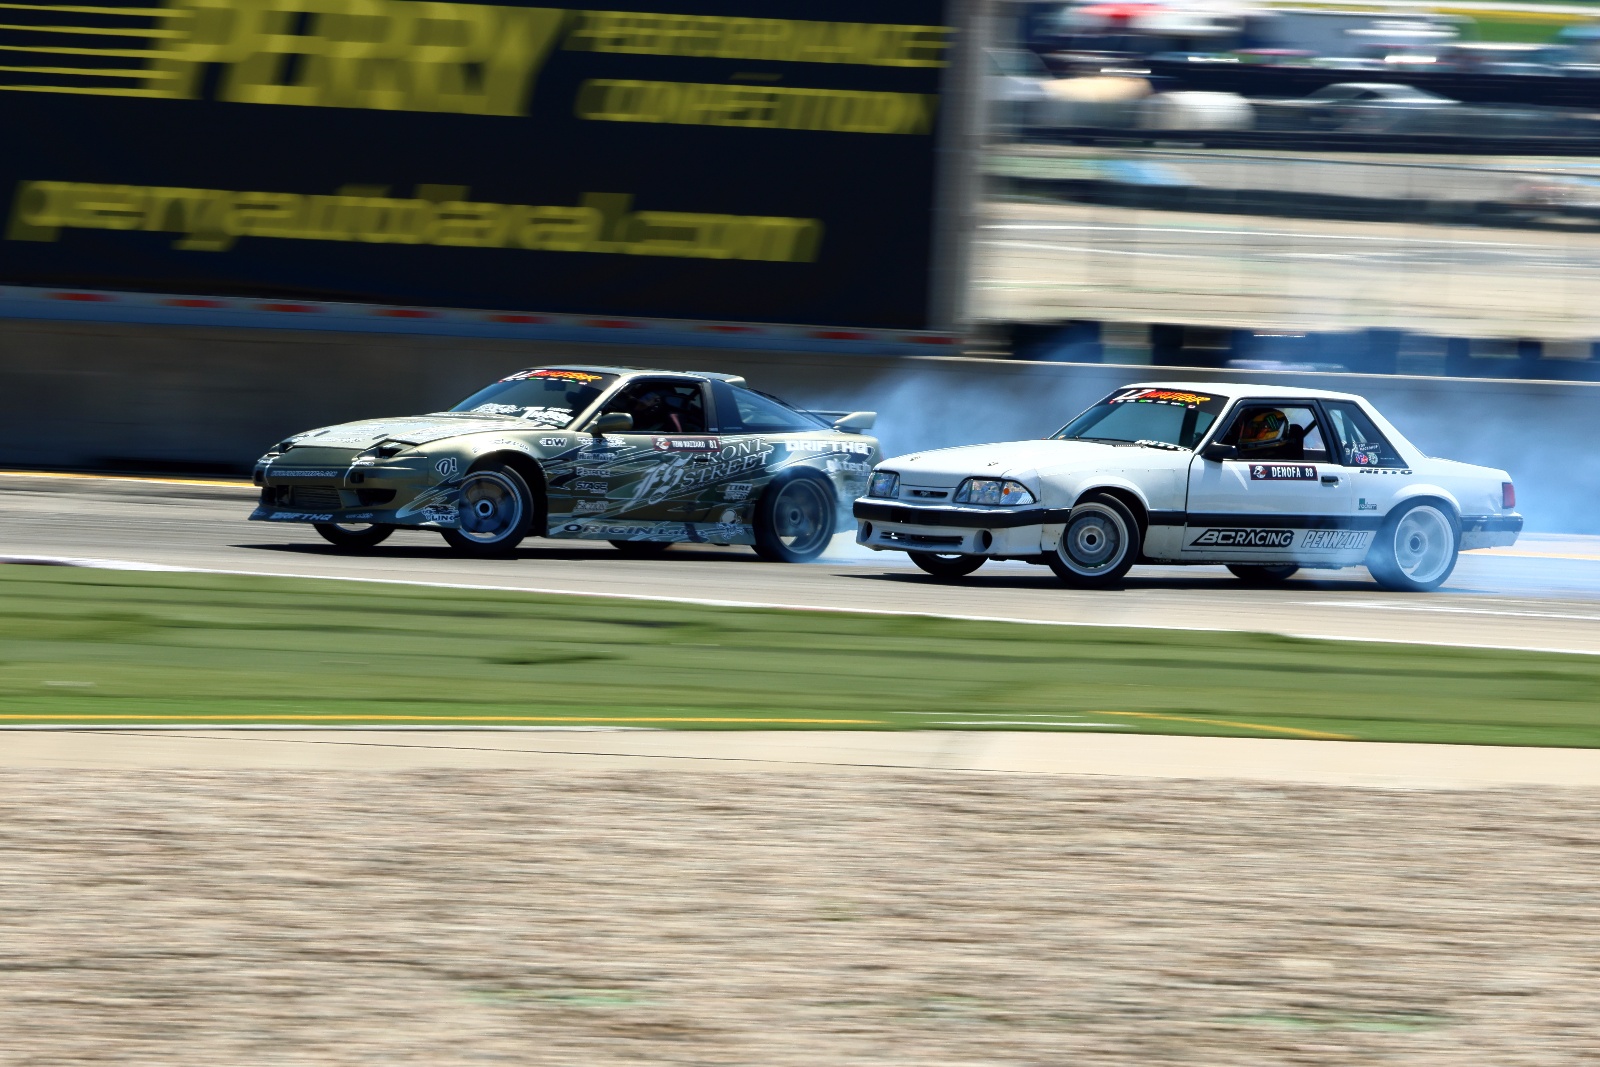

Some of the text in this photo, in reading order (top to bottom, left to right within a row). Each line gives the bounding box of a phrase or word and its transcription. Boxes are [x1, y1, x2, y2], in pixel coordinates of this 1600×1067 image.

[683, 450, 772, 485] STREET
[1271, 466, 1314, 478] DENOFA 88
[576, 481, 608, 490] STAGE
[564, 524, 656, 535] ORIGIN
[1301, 530, 1369, 549] PENNZOIL
